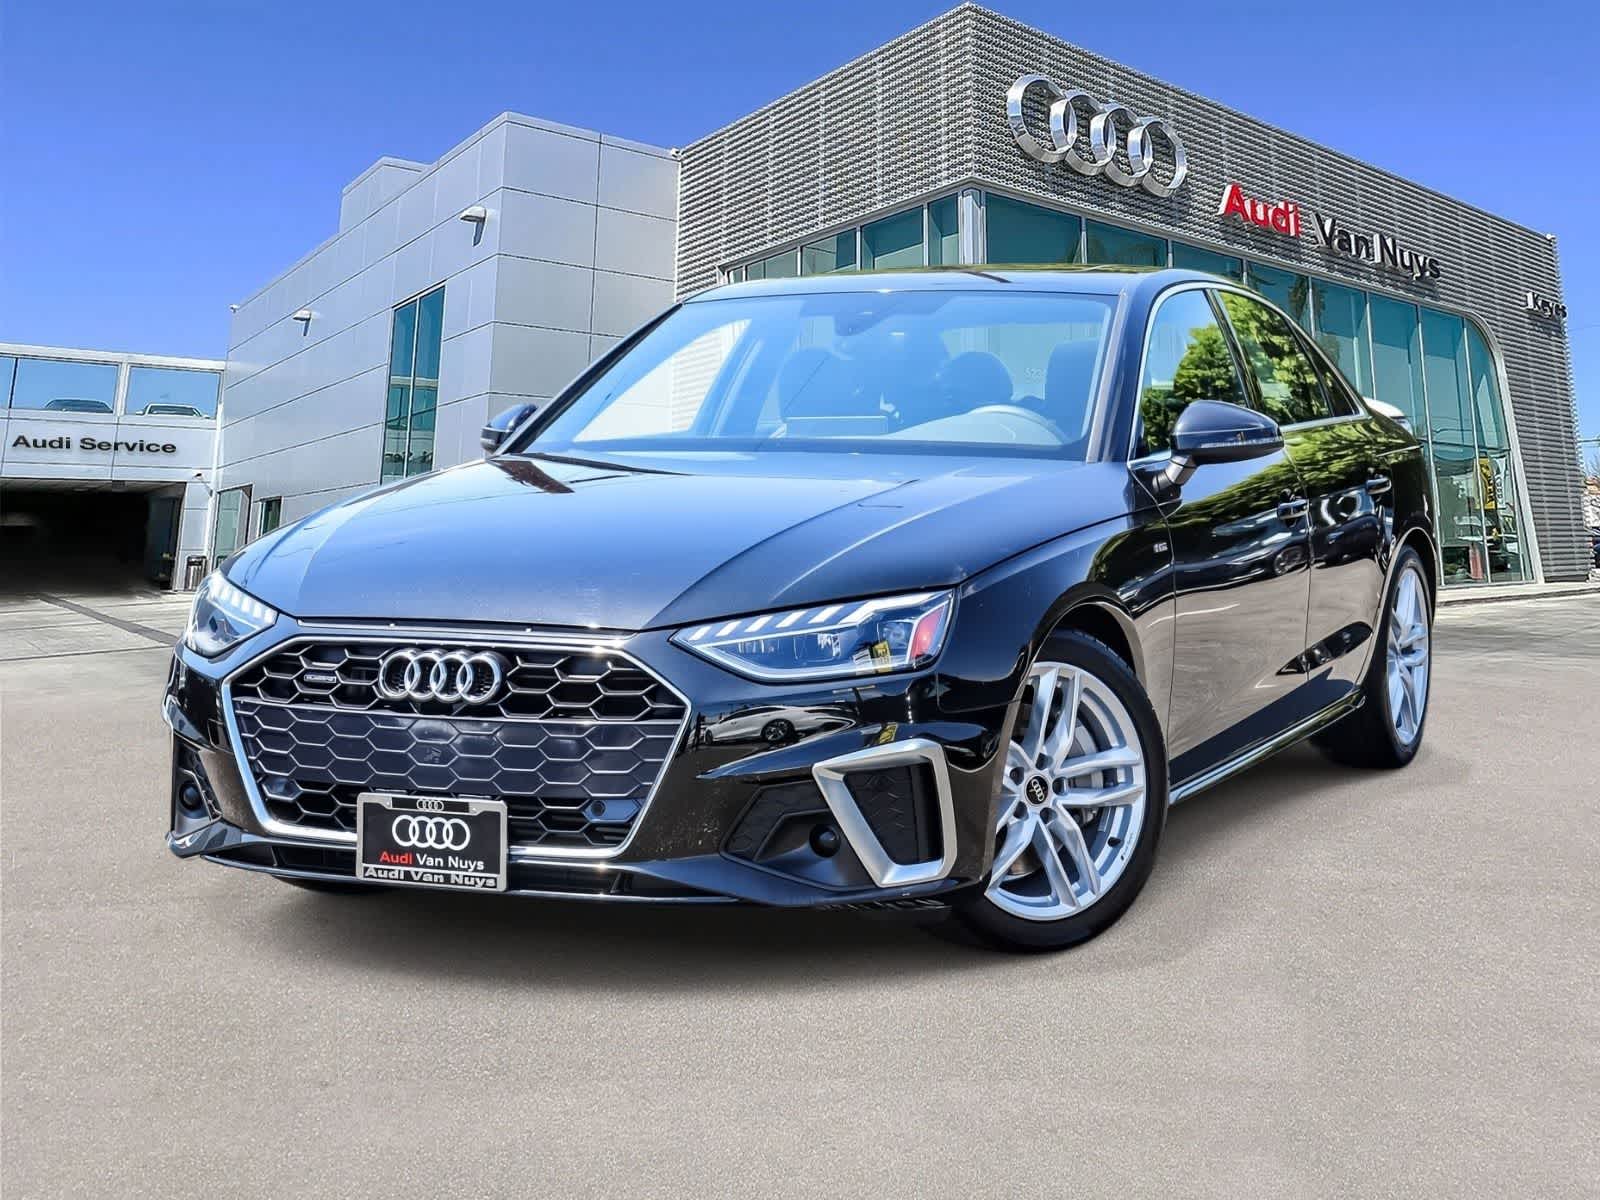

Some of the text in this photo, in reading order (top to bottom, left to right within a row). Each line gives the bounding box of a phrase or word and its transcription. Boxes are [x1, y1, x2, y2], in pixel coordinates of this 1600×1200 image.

[1219, 183, 1440, 280] Audi Van Nuys
[1527, 291, 1568, 318] Keyes
[12, 435, 177, 453] Audi Service
[380, 851, 485, 872] Audi Van Nuys
[365, 868, 497, 888] Audi Van Nuys
